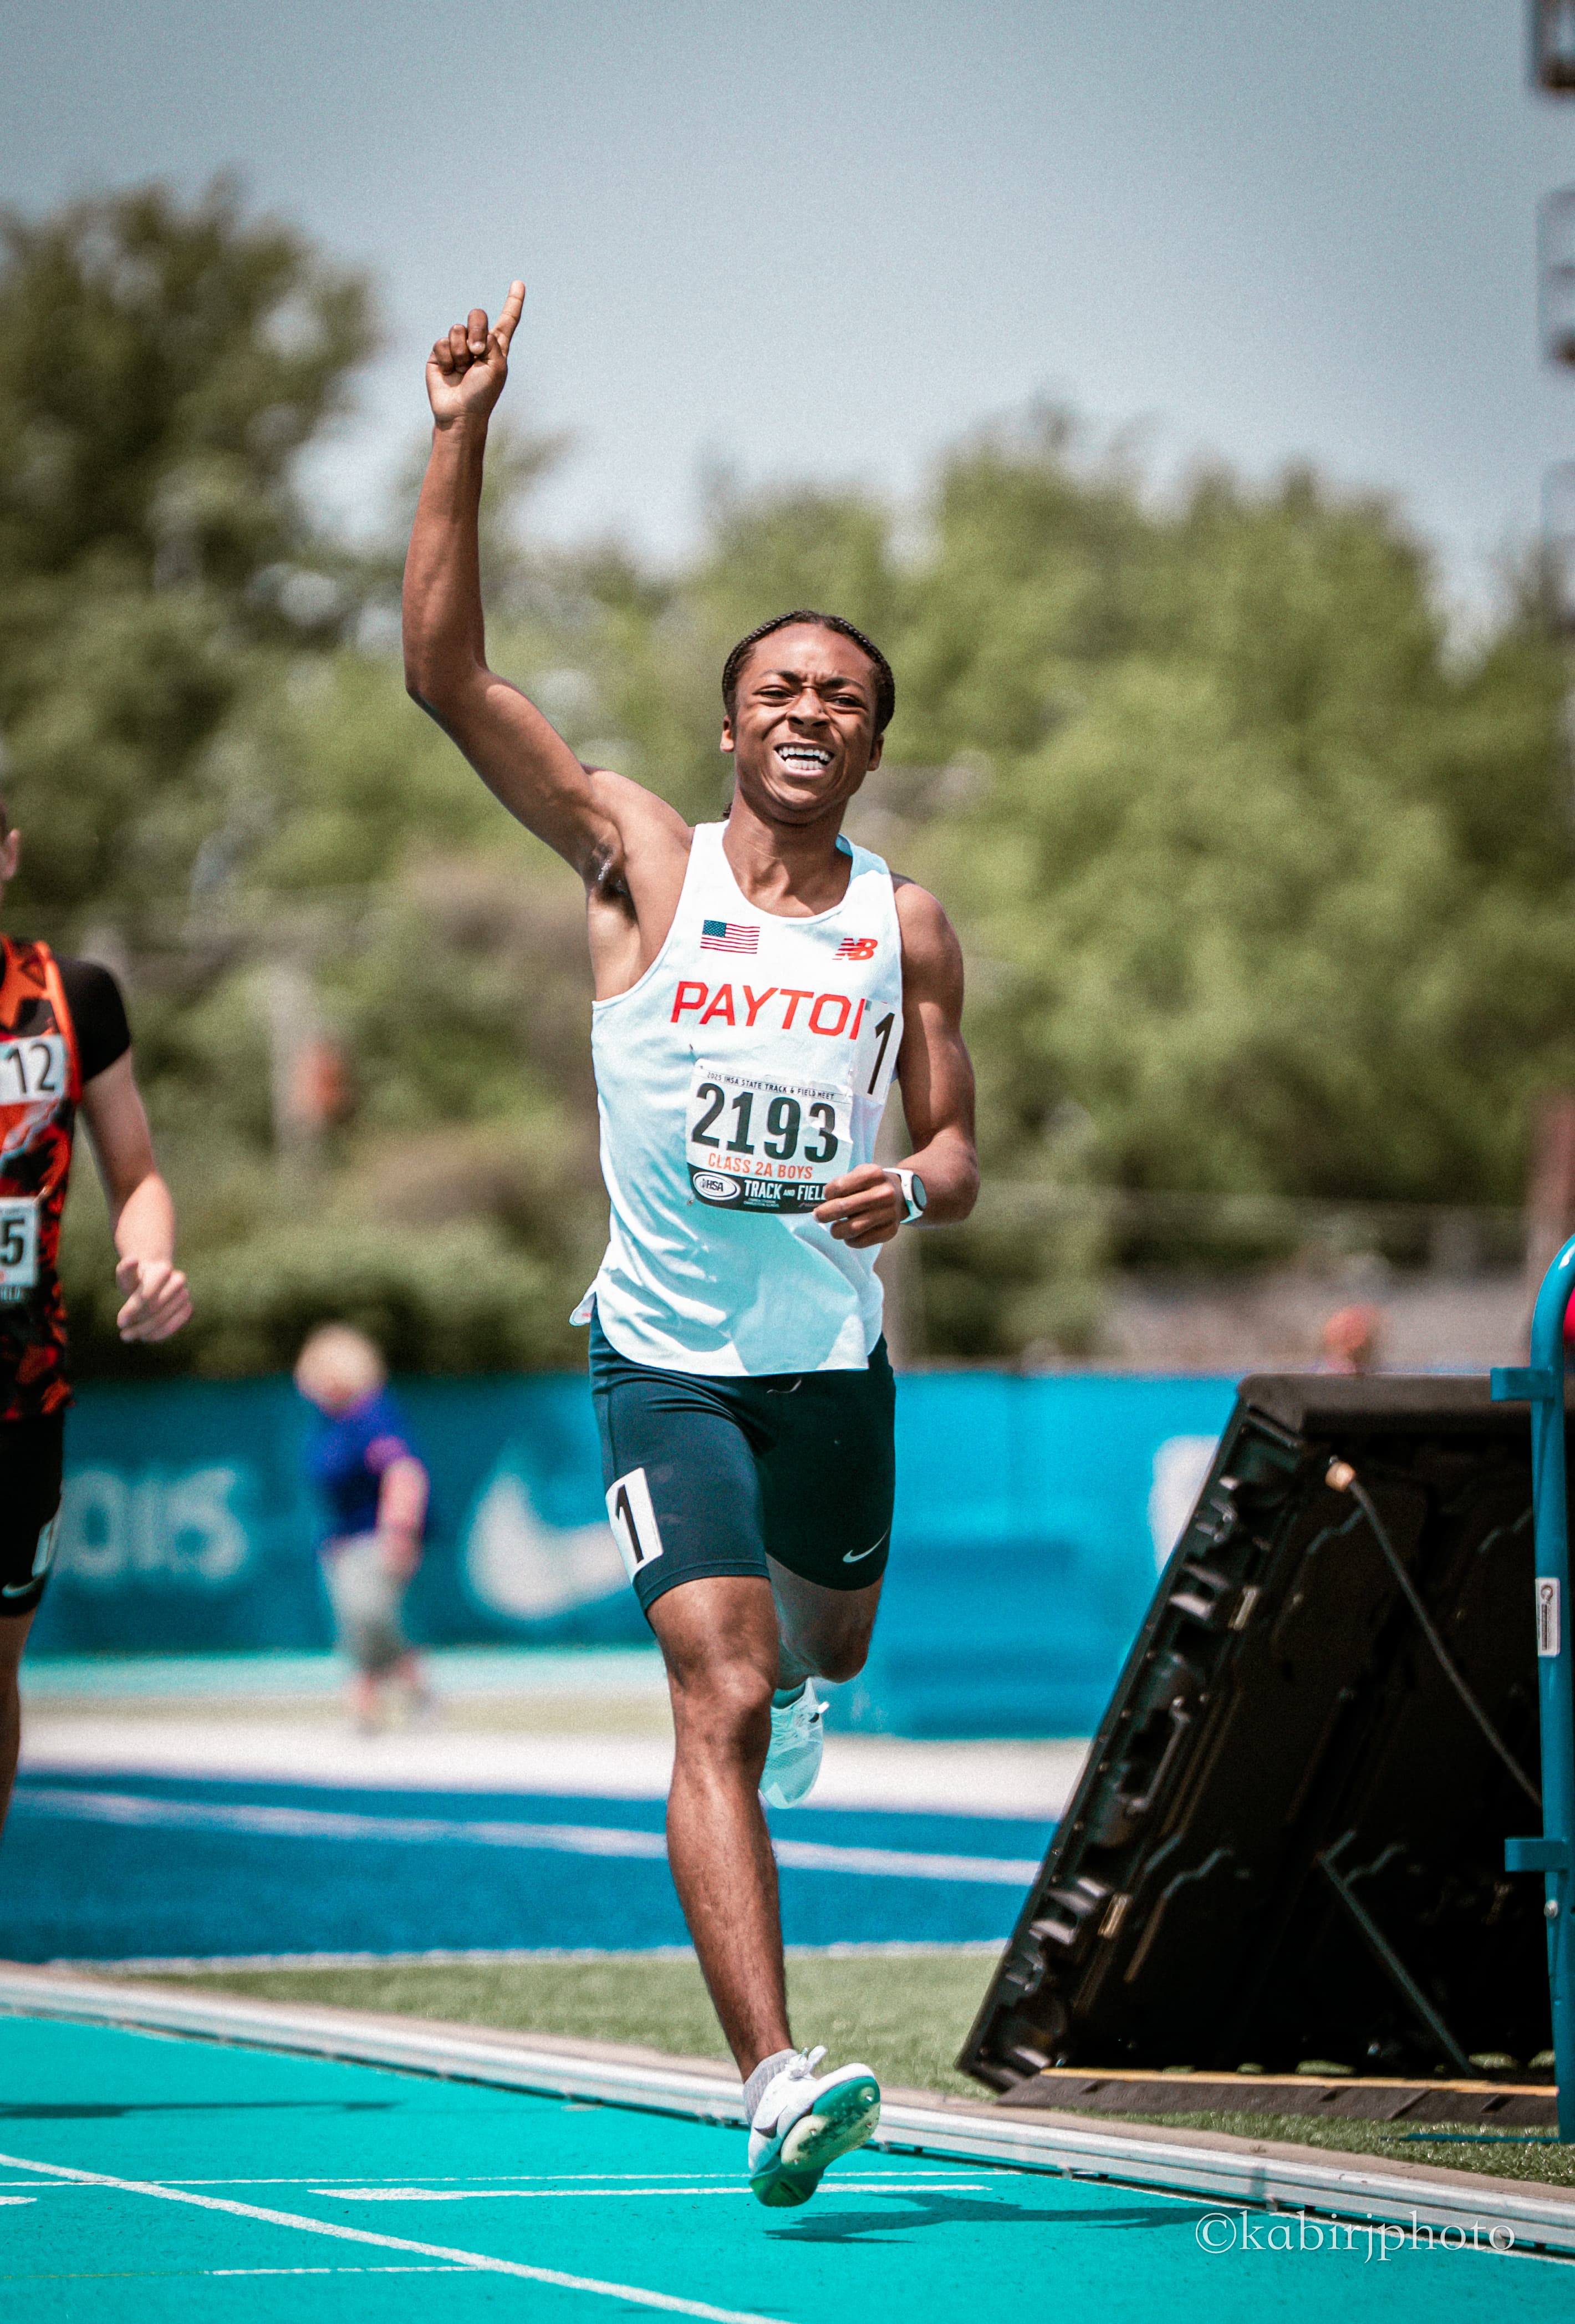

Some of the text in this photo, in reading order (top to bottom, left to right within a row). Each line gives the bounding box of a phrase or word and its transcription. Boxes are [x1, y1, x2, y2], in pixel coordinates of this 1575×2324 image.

[5, 1043, 55, 1094] 12
[867, 1012, 895, 1095] 1
[724, 1075, 738, 1085] IHSA
[742, 1080, 761, 1089] STATE
[765, 1084, 786, 1093] TRACK
[797, 1089, 815, 1097] FIELD
[691, 1083, 838, 1163] 2193
[709, 1153, 813, 1179] CLASS 2A BOYS
[744, 1179, 783, 1199] TRACK
[0, 1218, 25, 1267] 5
[615, 1483, 644, 1564] 1
